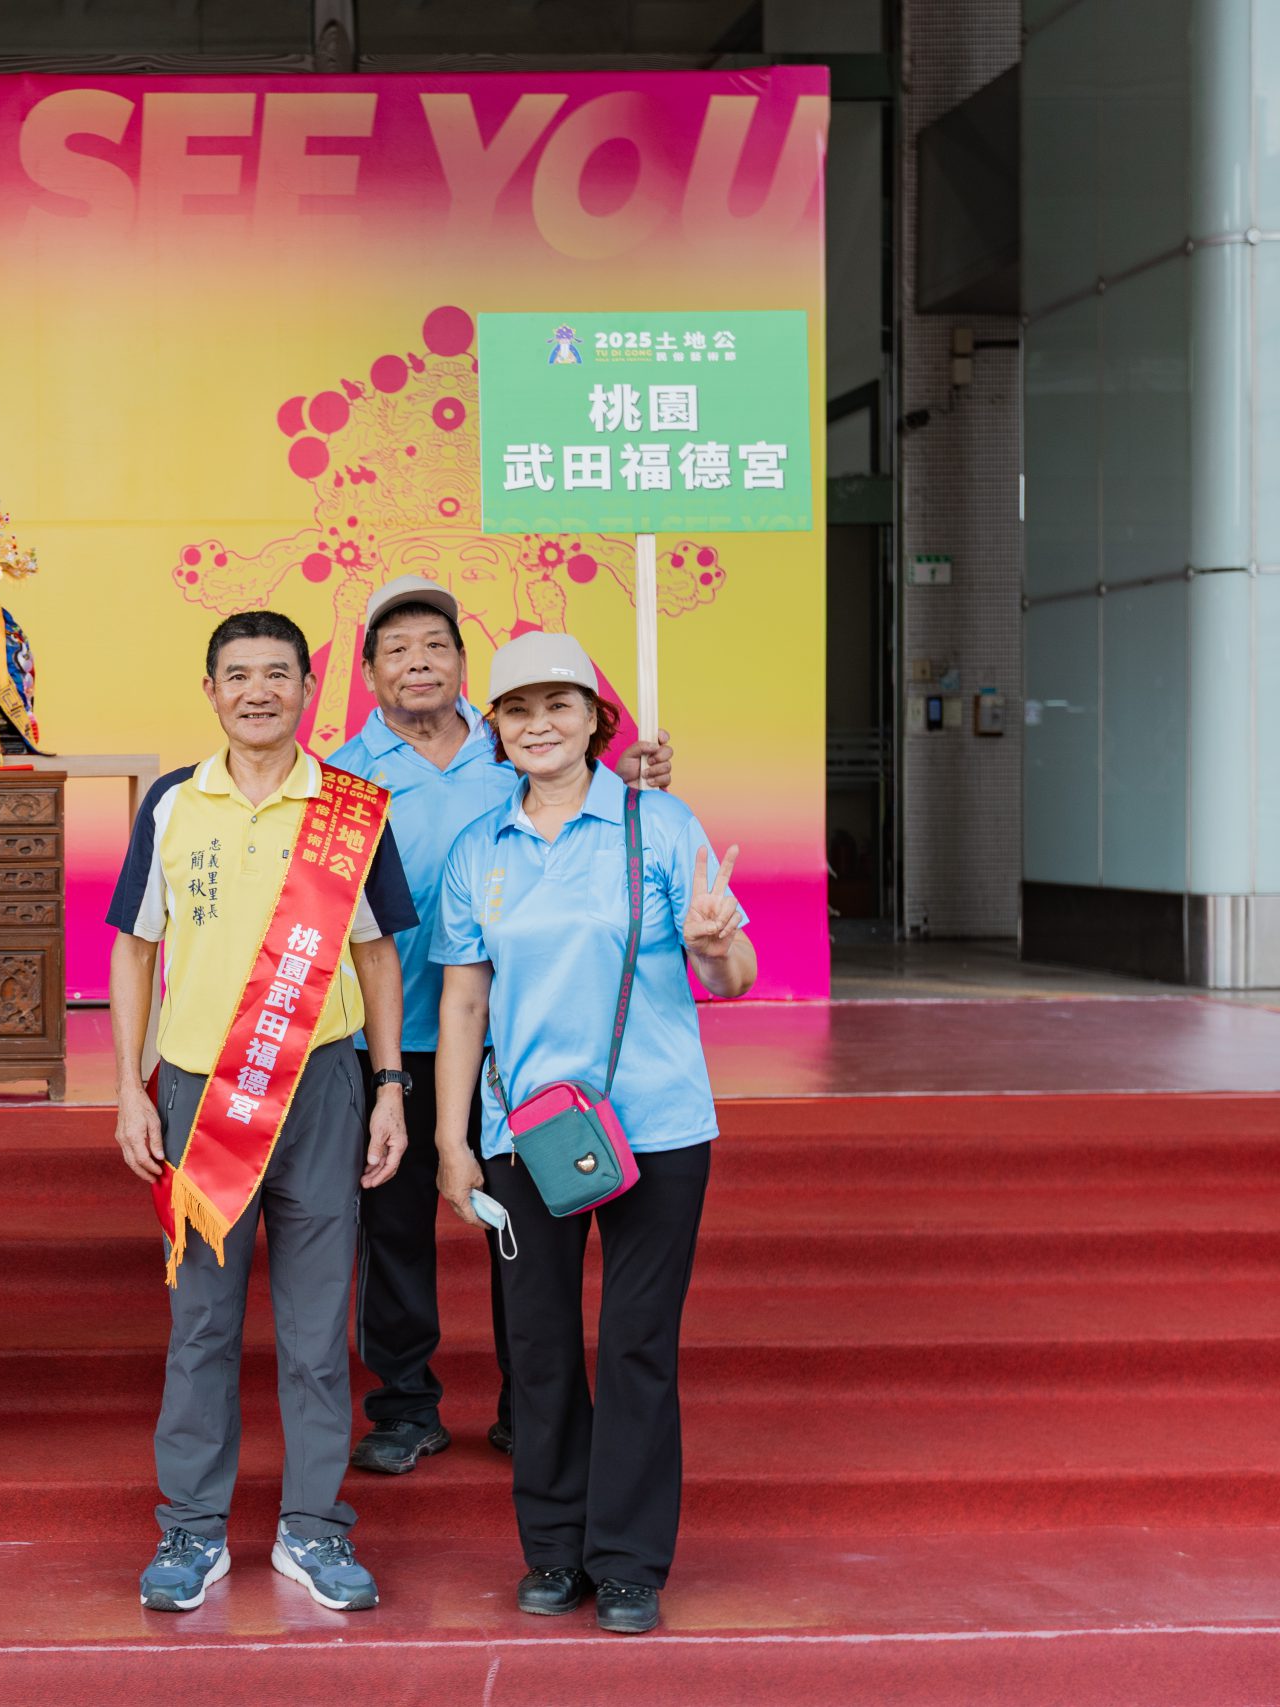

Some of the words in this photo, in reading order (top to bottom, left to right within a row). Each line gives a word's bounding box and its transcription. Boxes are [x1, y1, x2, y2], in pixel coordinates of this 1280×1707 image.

[18, 89, 378, 254] SEE
[419, 89, 829, 261] YOU
[594, 331, 652, 349] 2025
[655, 330, 736, 349] 土地公
[588, 383, 699, 432] 桃園
[502, 441, 788, 491] 武田福德宮
[323, 771, 379, 796] 2025
[333, 796, 343, 814] FOLK
[335, 785, 347, 794] DI
[349, 789, 378, 804] GONG
[328, 814, 339, 833] ARTS
[329, 802, 371, 881] 土地公
[318, 832, 333, 867] FESTIVAL
[188, 850, 207, 926] 簡秋榮
[208, 838, 221, 919] 忠義里里長
[630, 857, 641, 920] GOODS
[226, 923, 322, 1125] 桃園武田福德宮
[615, 972, 632, 1038] GOODS
